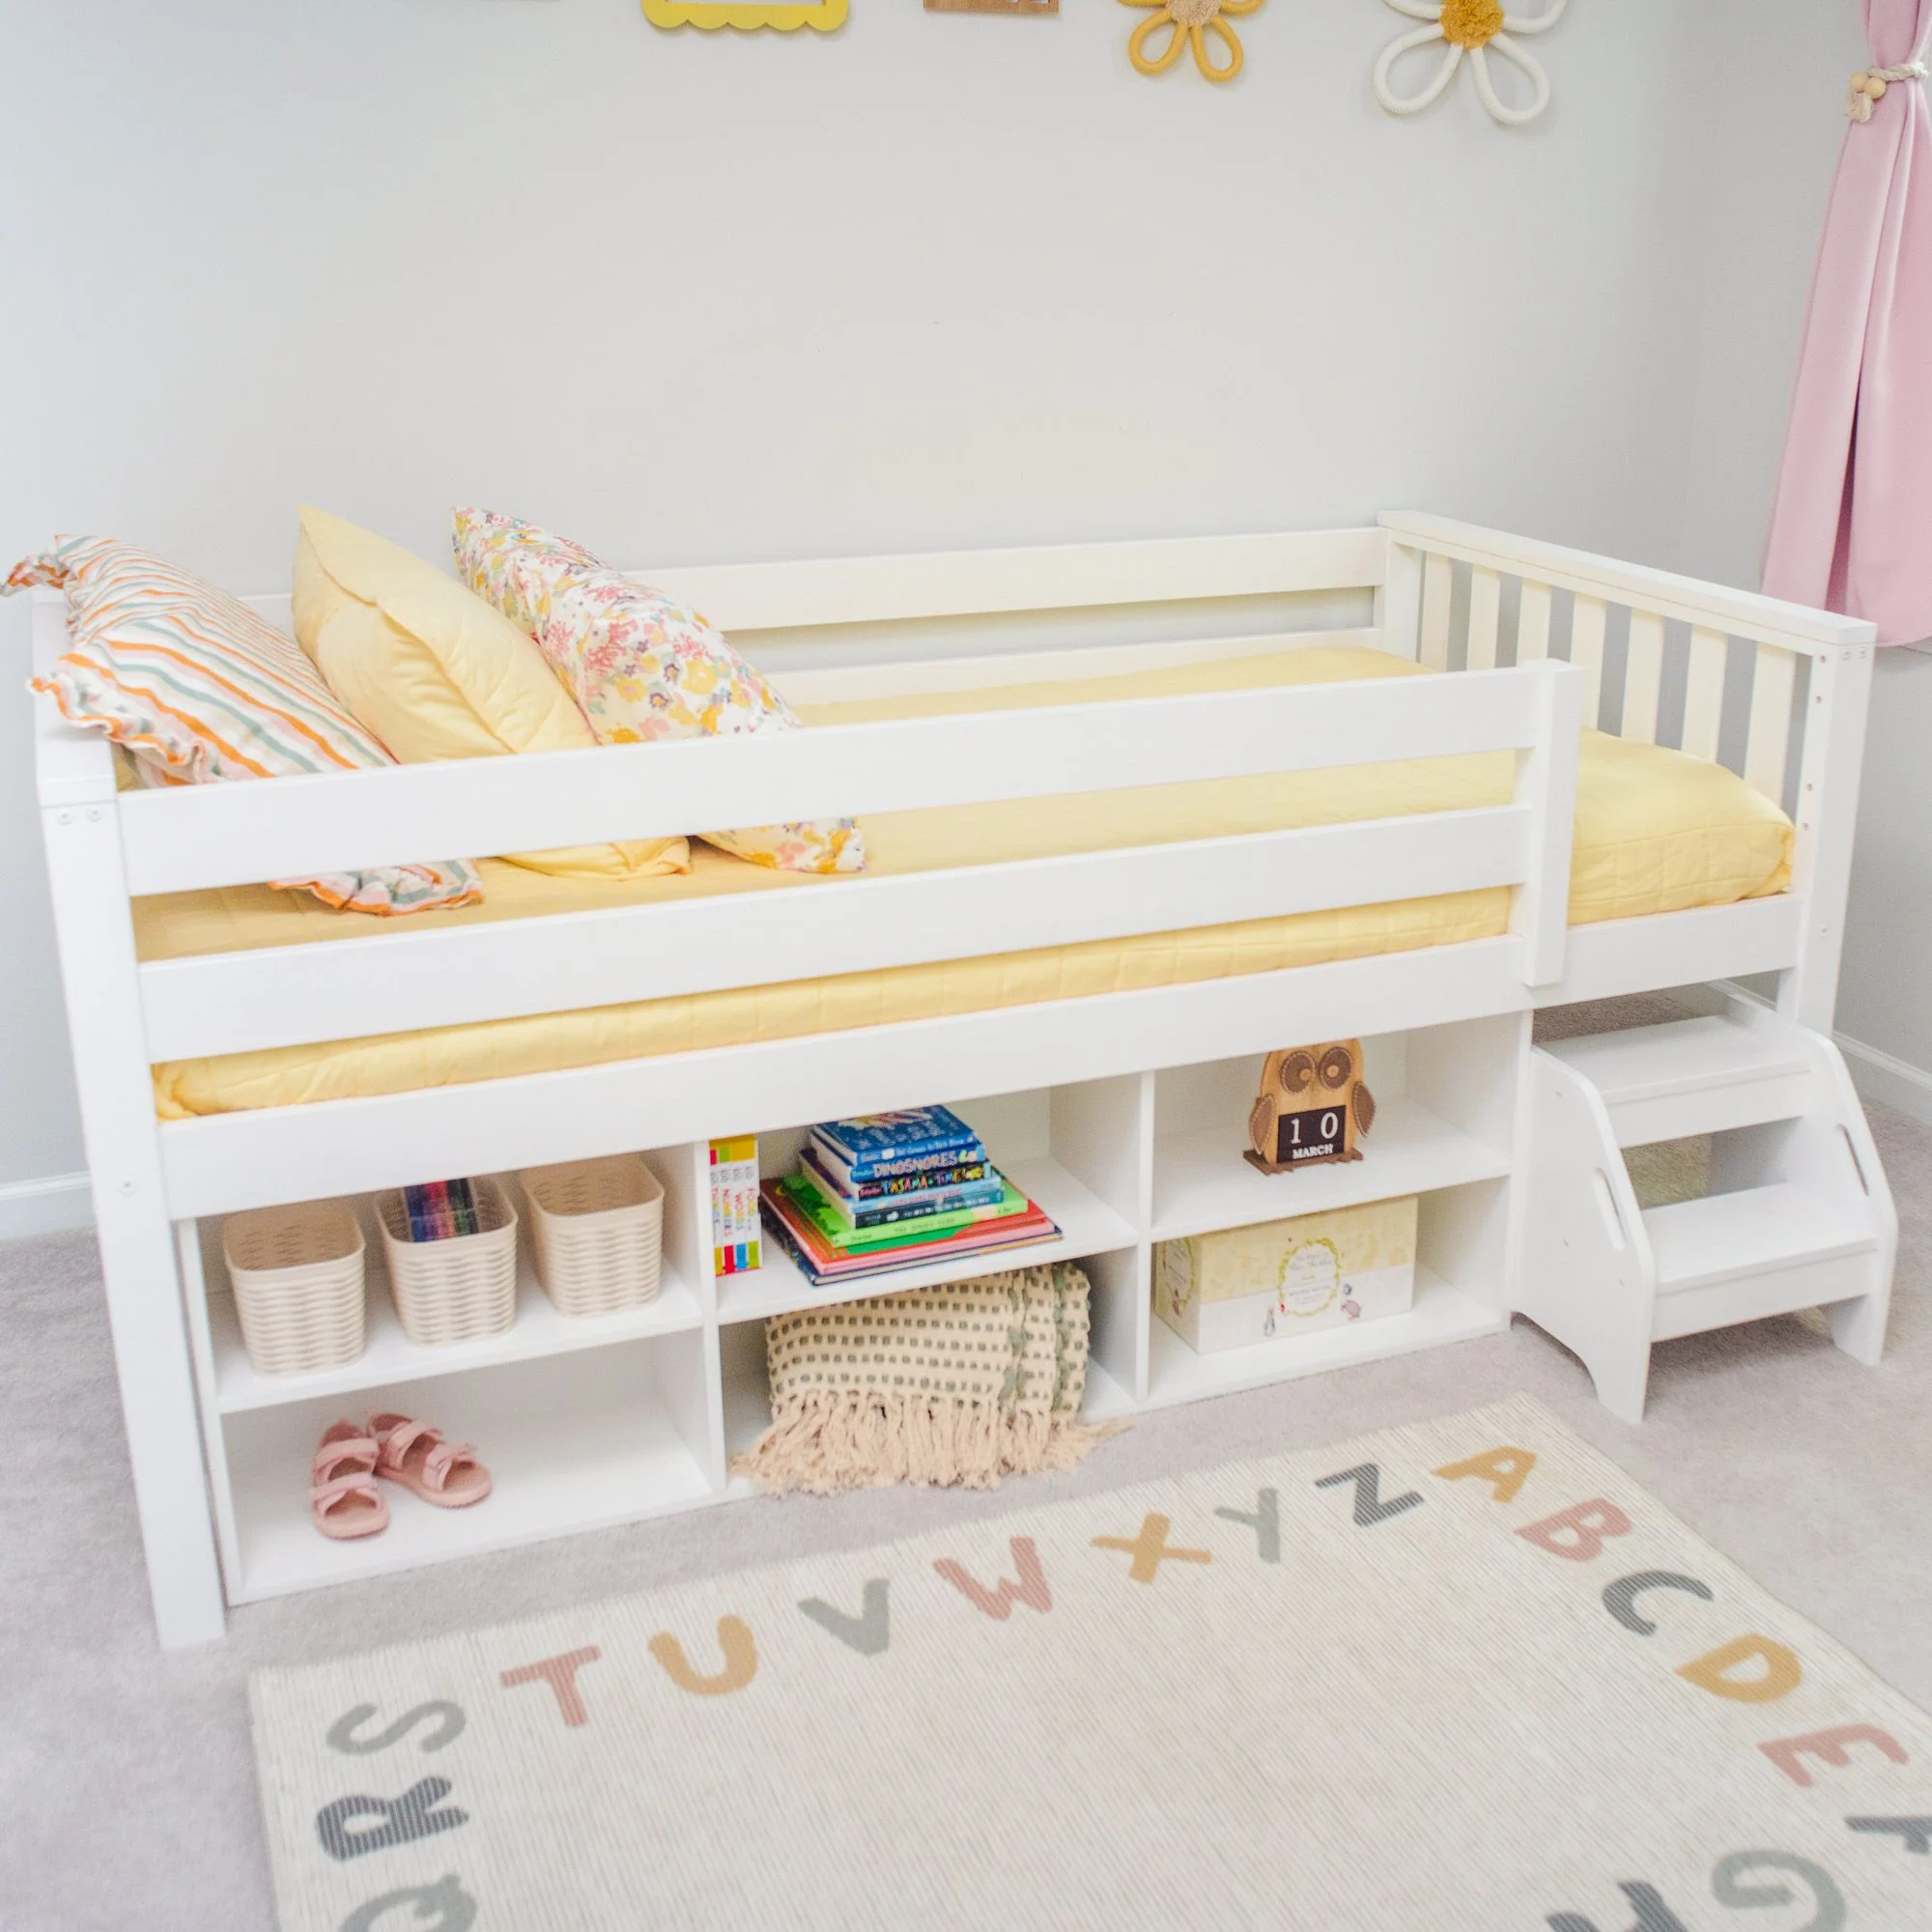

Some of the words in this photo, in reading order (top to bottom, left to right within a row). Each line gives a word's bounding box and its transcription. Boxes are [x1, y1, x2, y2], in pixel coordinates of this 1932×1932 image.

[872, 1151, 958, 1178] DINOSNORES
[881, 1176, 928, 1196] PAJAMA
[1292, 1143, 1334, 1160] MARCH
[501, 1646, 601, 1727] T
[649, 1616, 758, 1696] U
[798, 1579, 890, 1656] V
[933, 1537, 1052, 1621] W
[1092, 1513, 1211, 1584] X
[1215, 1488, 1280, 1563] Y
[1314, 1462, 1425, 1527] Z
[1434, 1446, 1537, 1503] A
[1516, 1499, 1631, 1561] B
[1602, 1569, 1713, 1637] C
[1674, 1634, 1804, 1704] D
[1757, 1724, 1908, 1788] E
[327, 1699, 467, 1756] S
[316, 1775, 469, 1862] R
[1711, 1849, 1847, 1932] G
